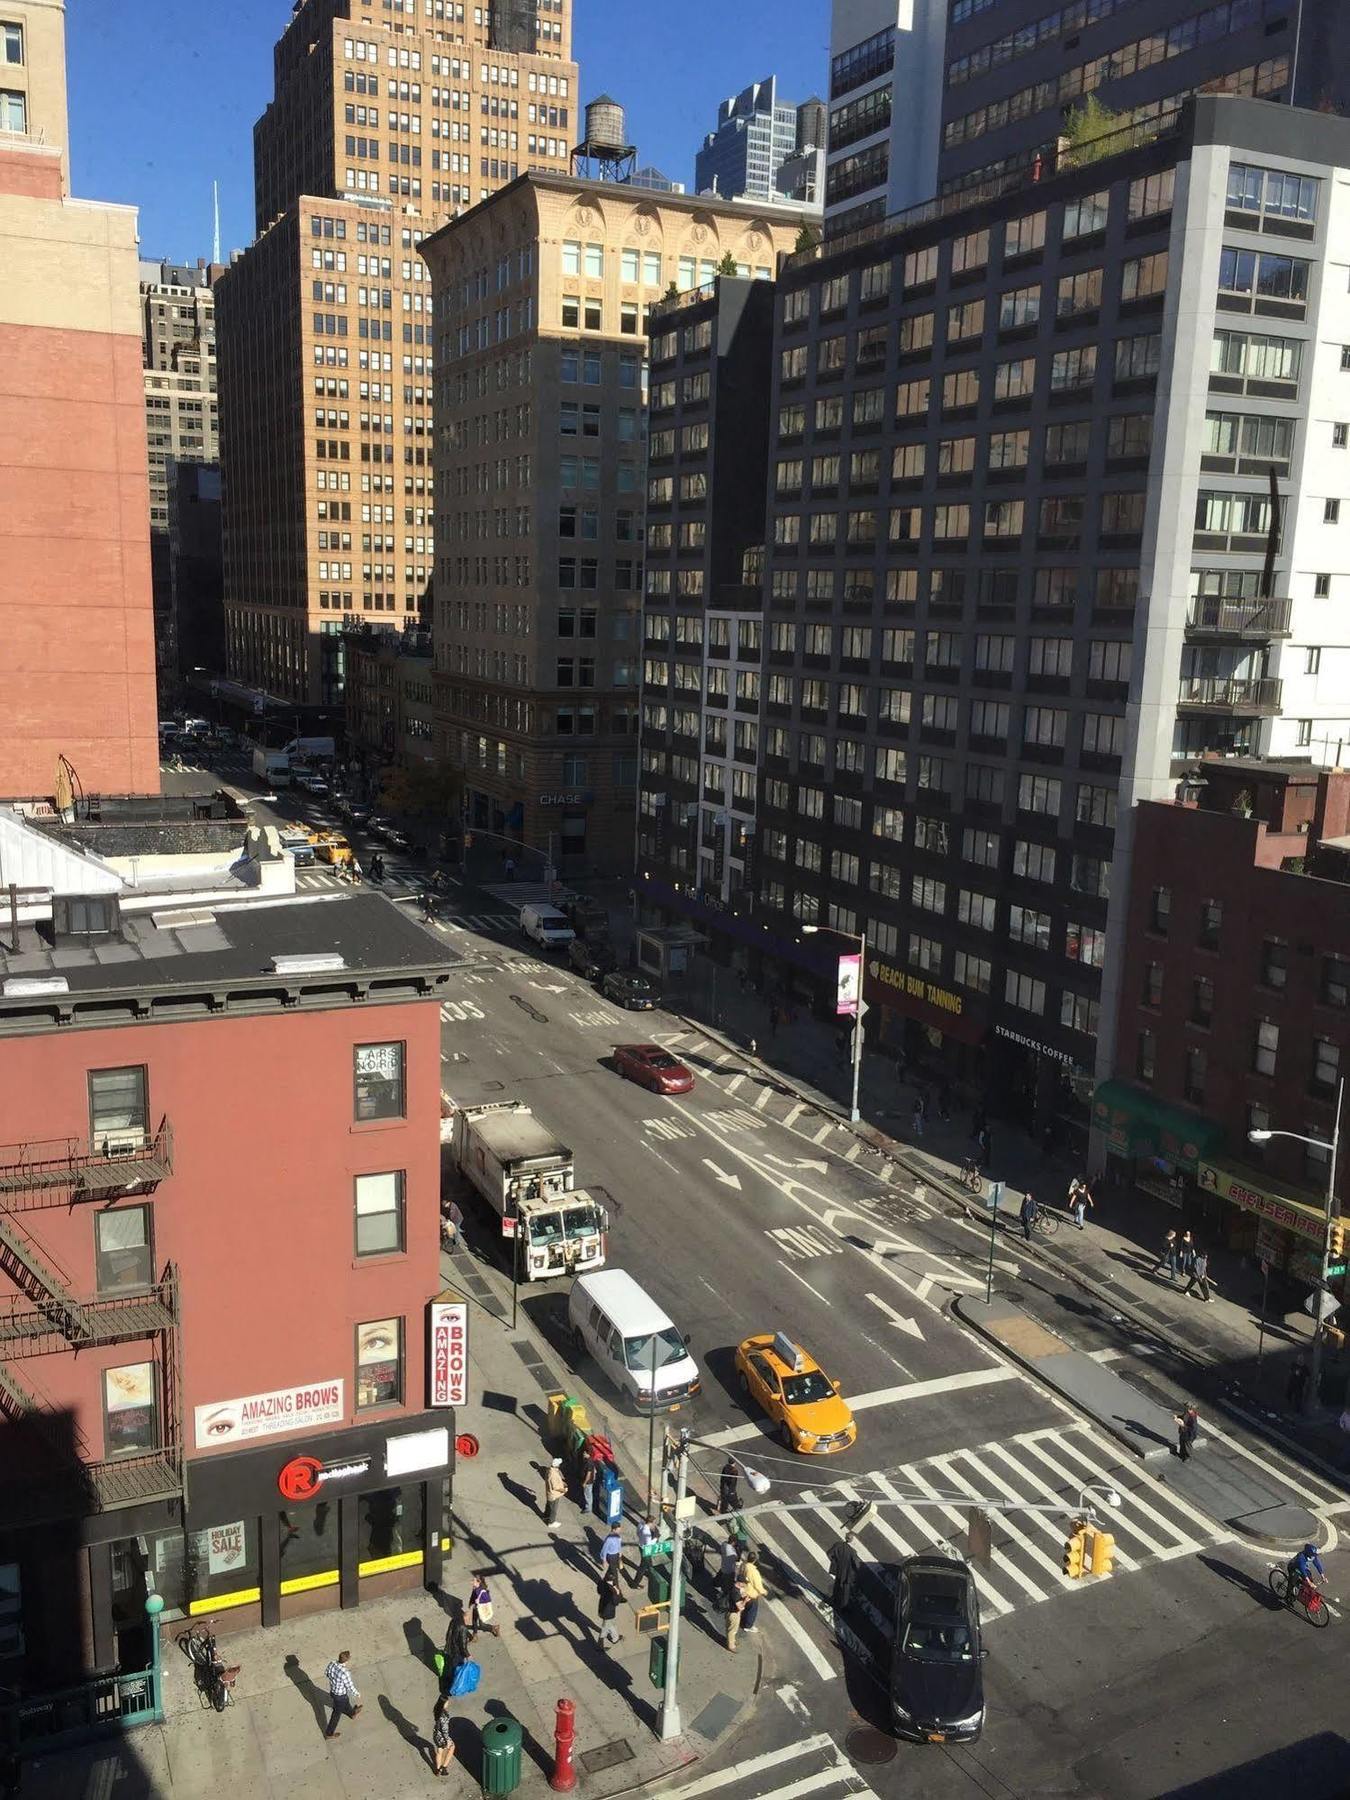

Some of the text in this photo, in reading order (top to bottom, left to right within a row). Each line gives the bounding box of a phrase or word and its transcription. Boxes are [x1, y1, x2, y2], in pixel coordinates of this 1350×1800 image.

[540, 795, 581, 804] CHASE
[879, 964, 962, 1015] BEACH BUM TANNING
[995, 1025, 1074, 1065] STARBUCKS COFFEE
[437, 1328, 447, 1400] AMAZING
[450, 1327, 463, 1401] BROWS
[241, 1396, 292, 1420] AMAZING
[295, 1386, 338, 1410] BROWS
[211, 1526, 241, 1539] HOLIDAY
[212, 1535, 242, 1554] SALE
[655, 1543, 663, 1554] 23
[19, 1703, 54, 1716] Subway
